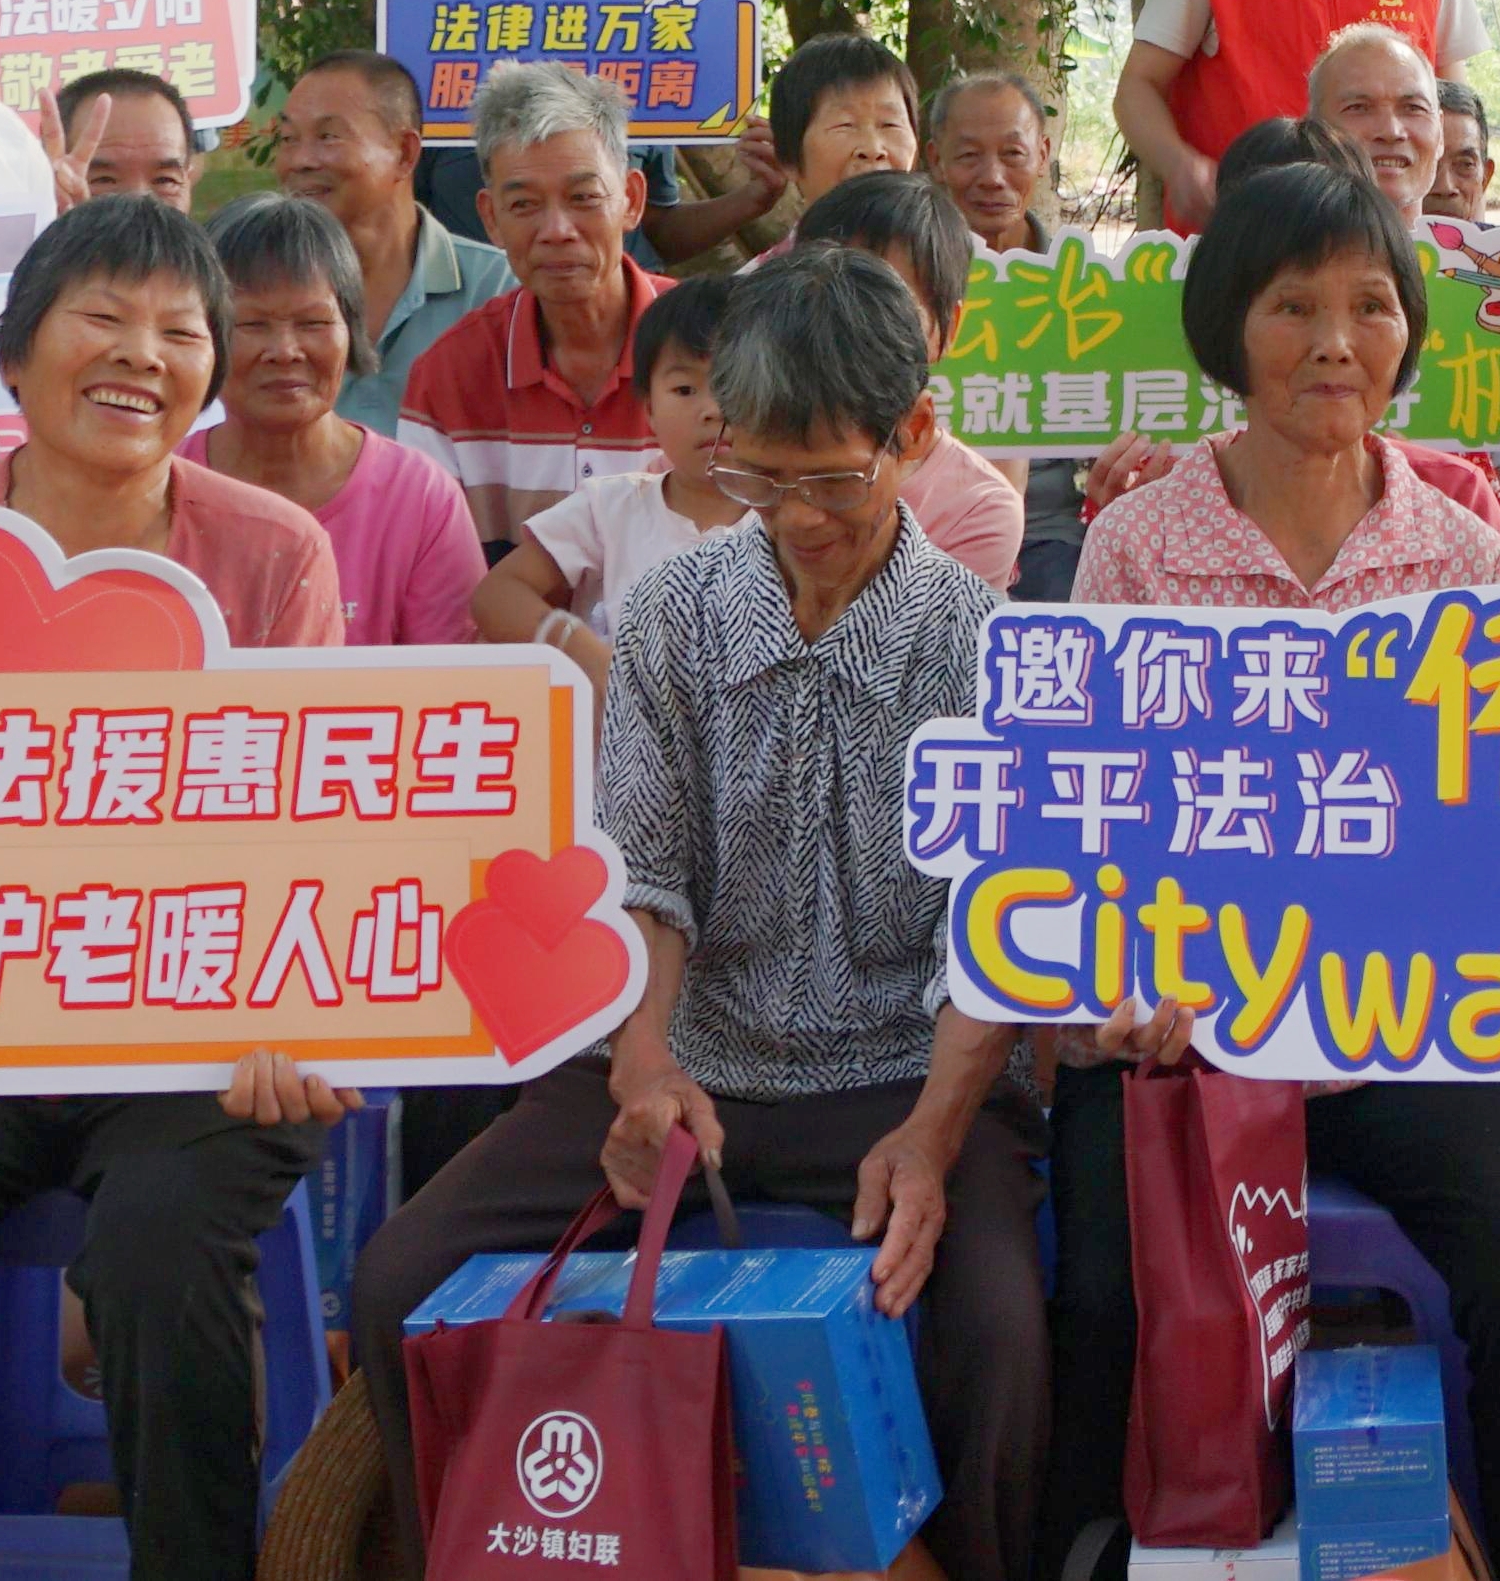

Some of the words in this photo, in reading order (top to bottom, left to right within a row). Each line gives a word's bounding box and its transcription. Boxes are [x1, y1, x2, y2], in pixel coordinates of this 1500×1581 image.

[430, 3, 698, 53] 法律进万家
[428, 60, 699, 111] 服距离
[911, 747, 1400, 859] 开平法治
[486, 1522, 621, 1566] 大沙镇妇联
